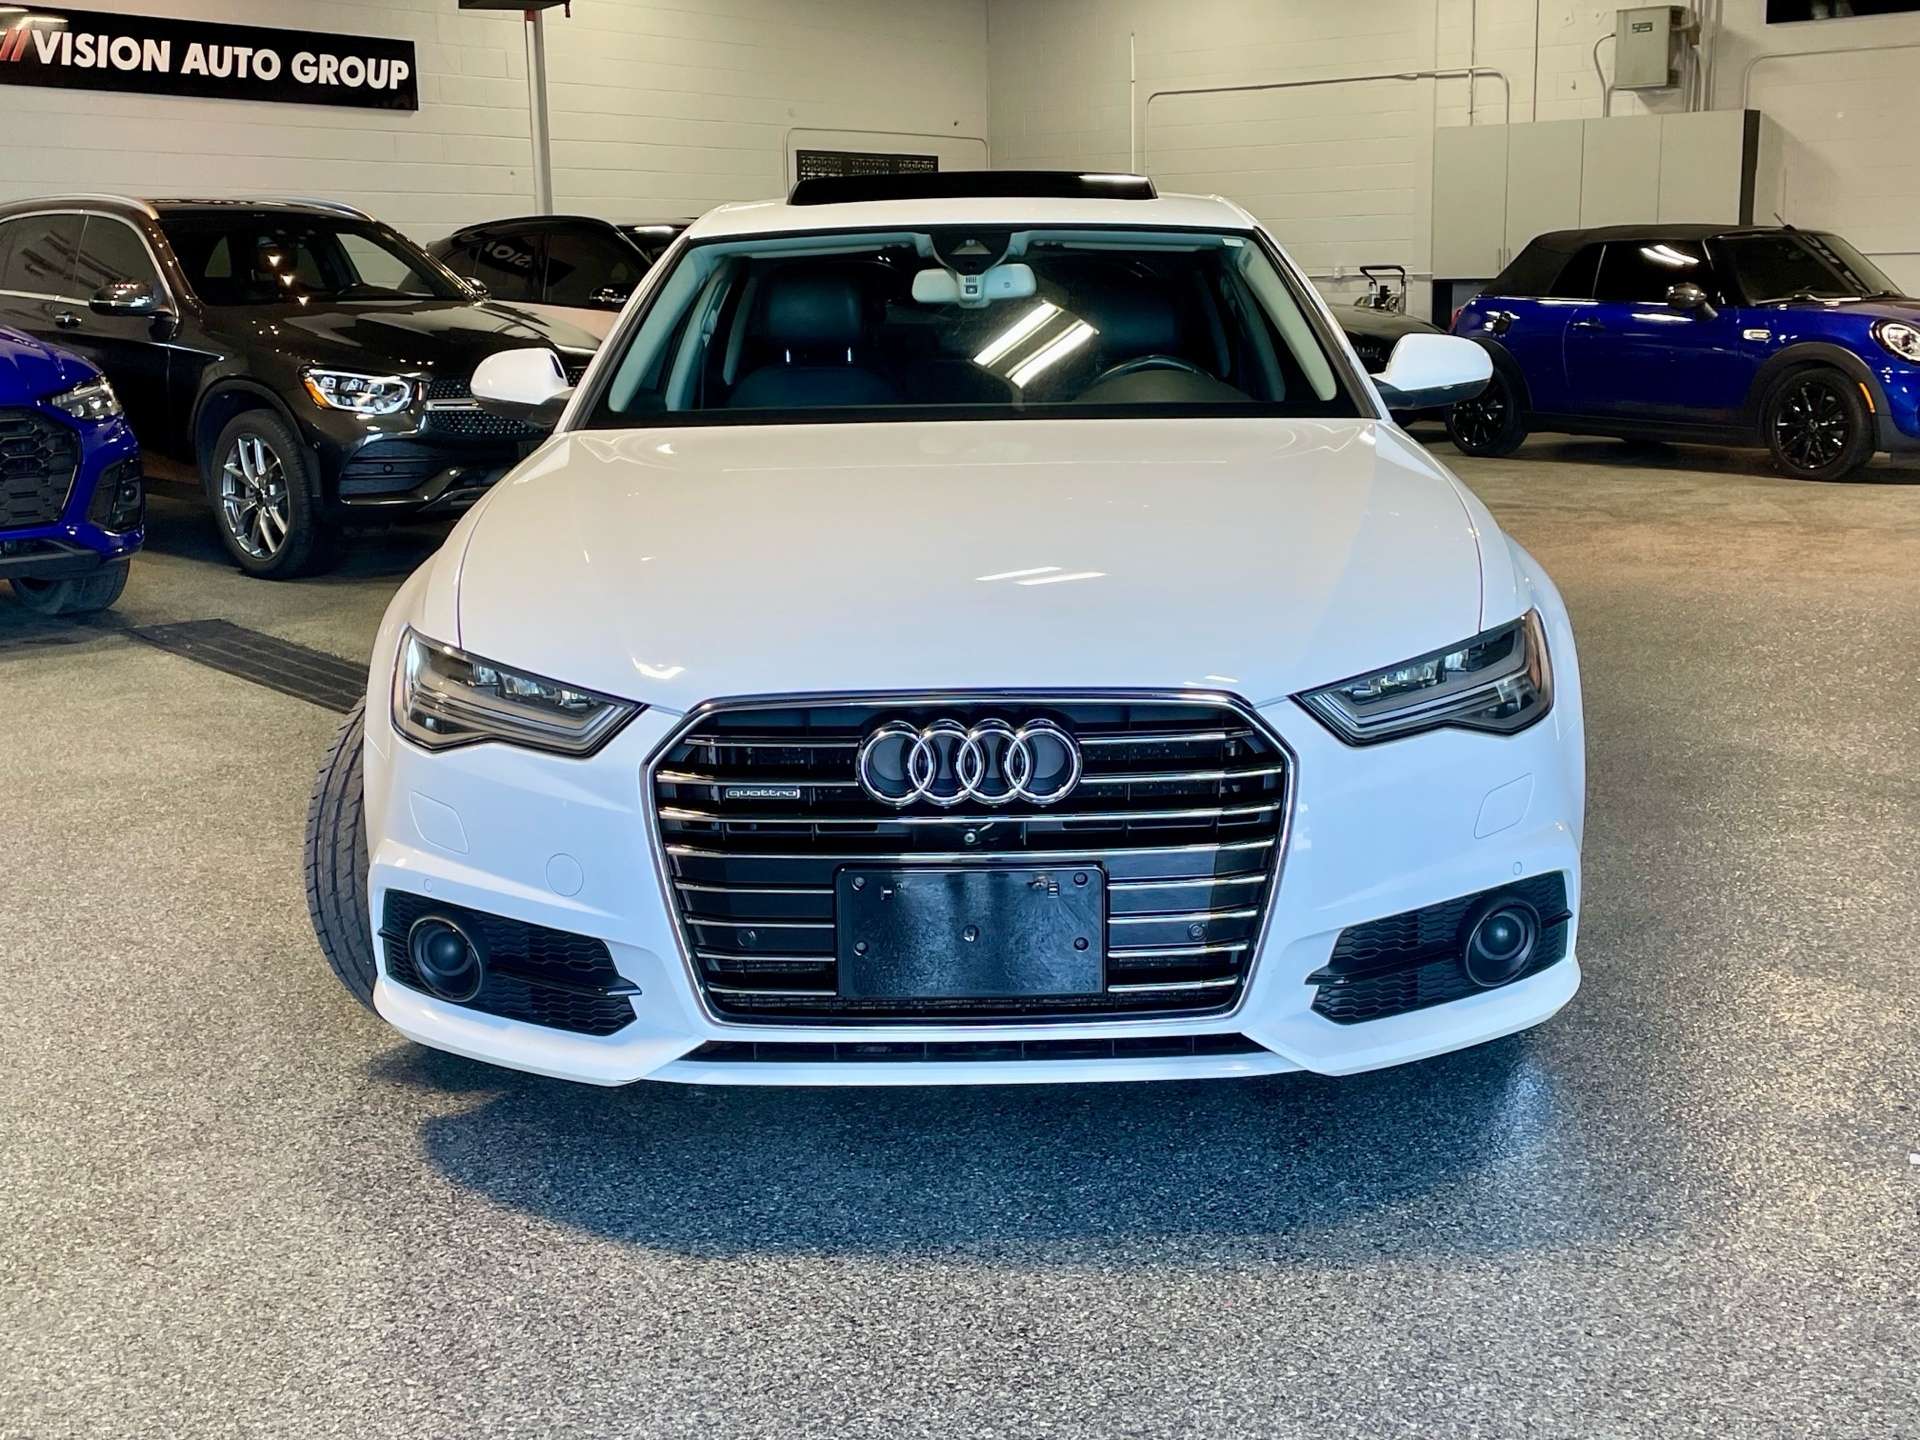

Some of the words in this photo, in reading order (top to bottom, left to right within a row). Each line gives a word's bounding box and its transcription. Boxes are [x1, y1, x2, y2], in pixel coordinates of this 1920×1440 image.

[31, 29, 171, 73] VISION
[180, 43, 282, 81] AUTO
[290, 51, 410, 90] GROUP
[728, 788, 797, 798] quattro
